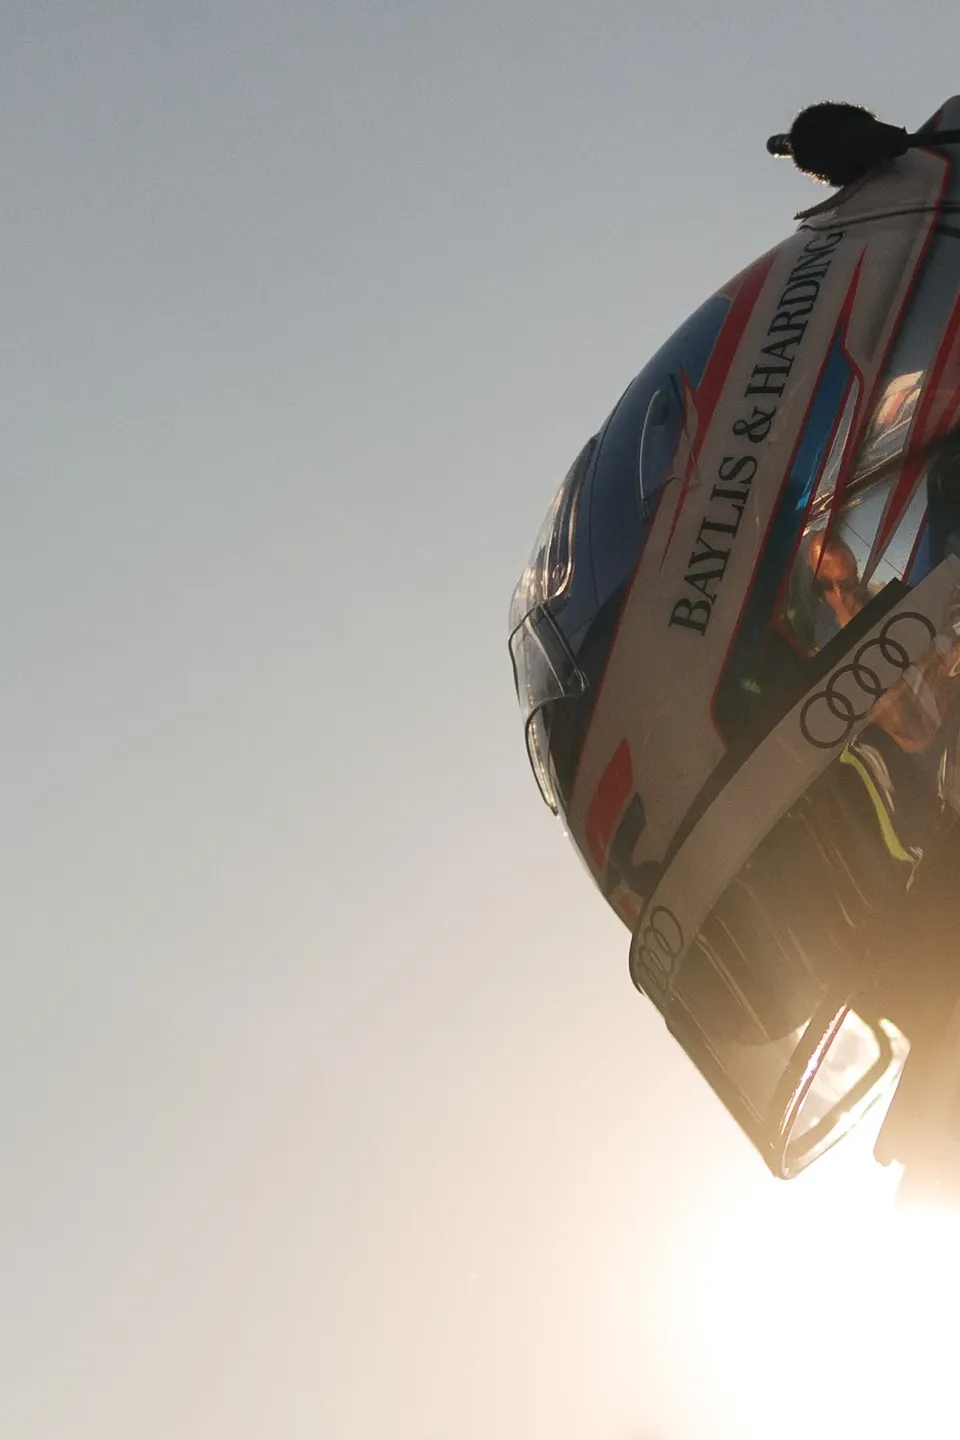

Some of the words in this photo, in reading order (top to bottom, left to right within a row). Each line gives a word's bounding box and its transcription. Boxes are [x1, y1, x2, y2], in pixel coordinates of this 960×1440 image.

[744, 229, 846, 400] HARDING
[732, 405, 777, 444] &
[668, 453, 758, 636] BAYLIS
